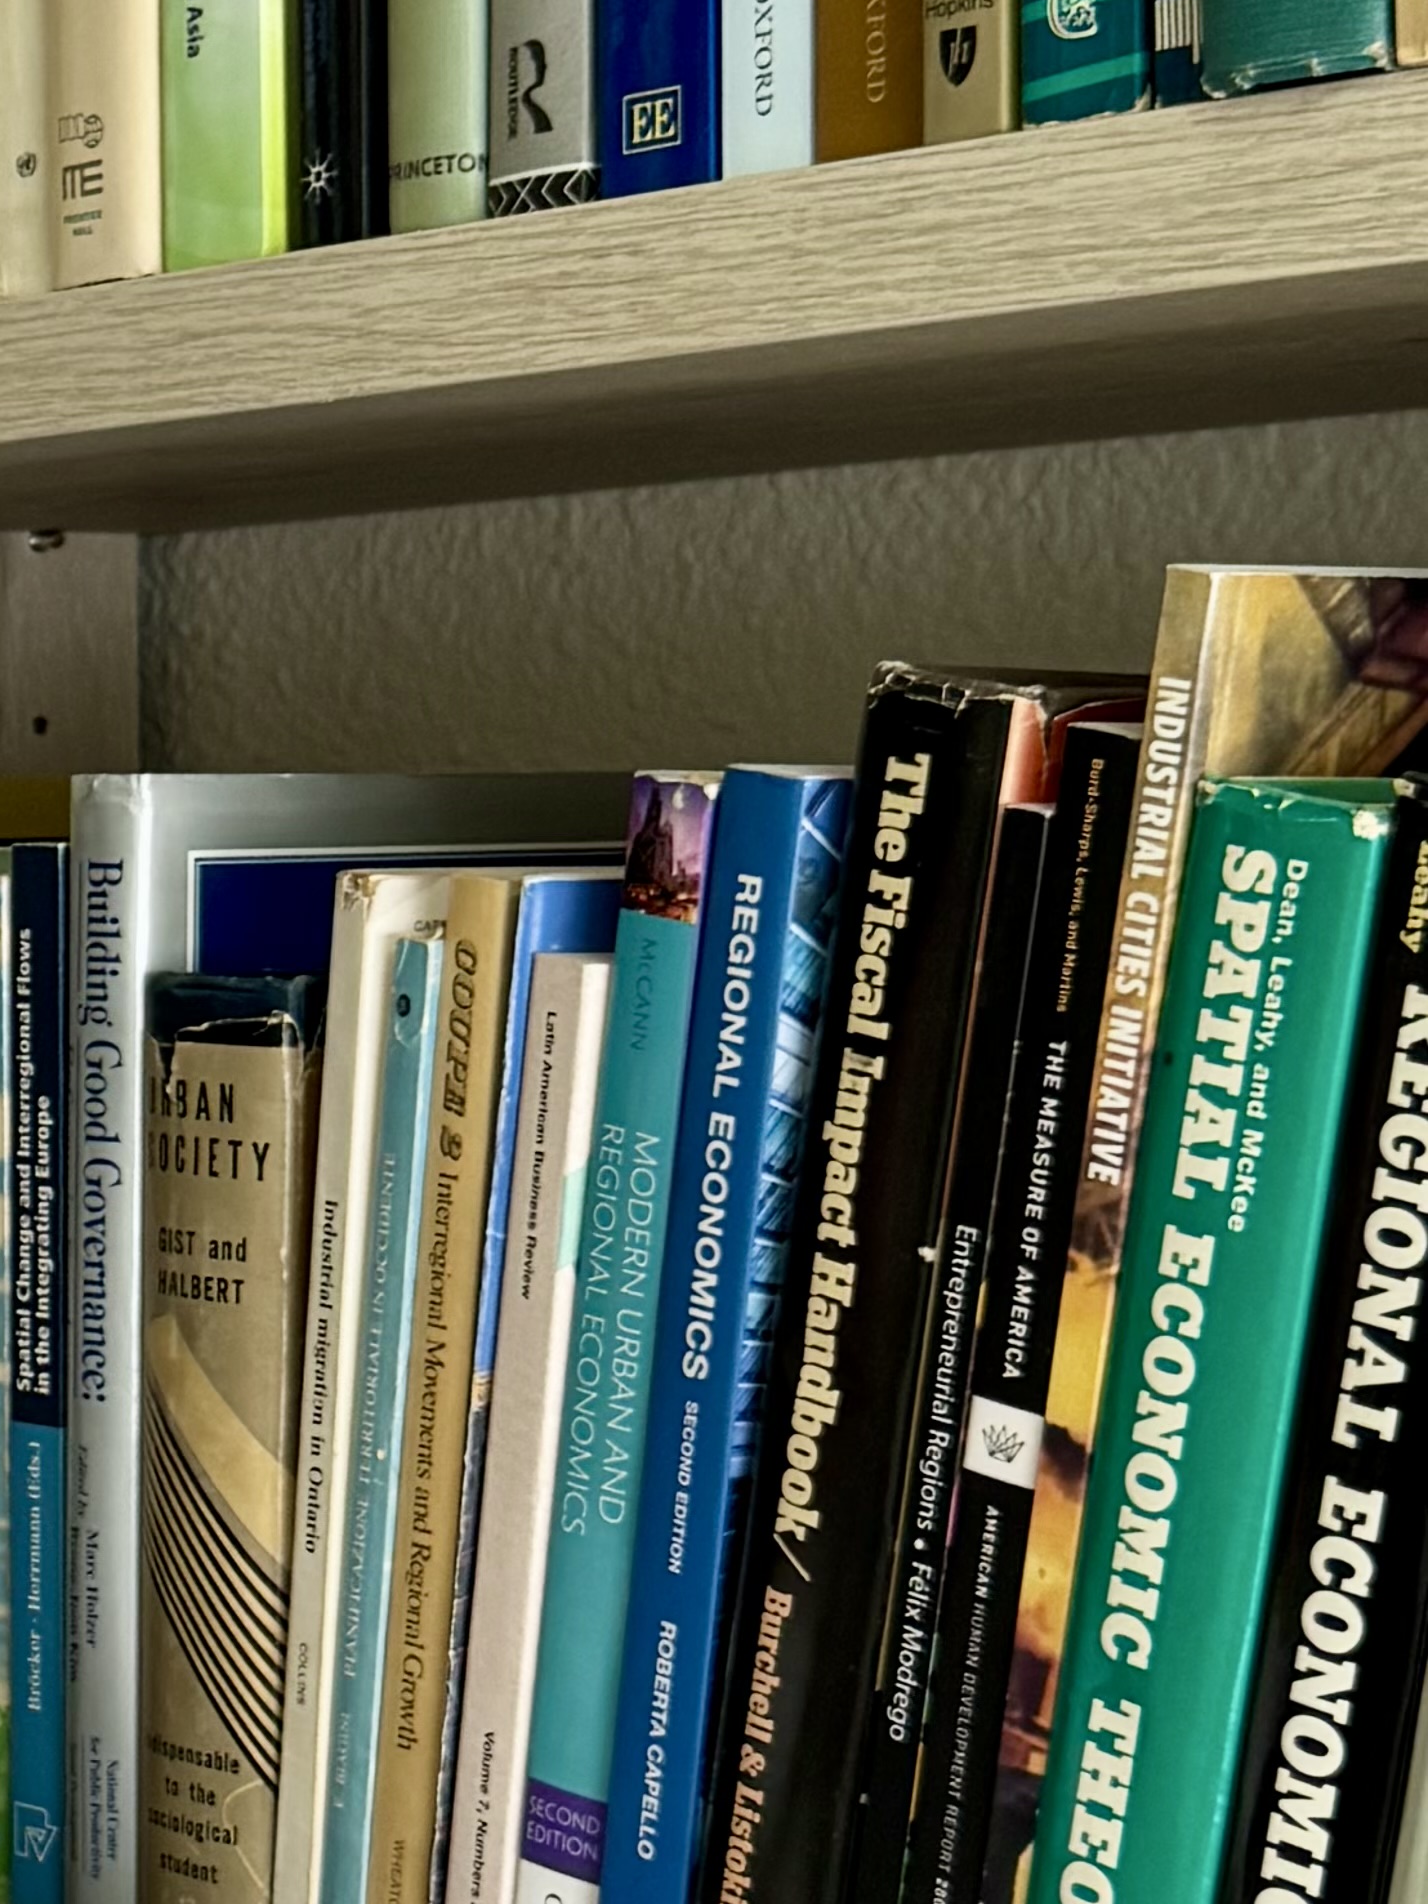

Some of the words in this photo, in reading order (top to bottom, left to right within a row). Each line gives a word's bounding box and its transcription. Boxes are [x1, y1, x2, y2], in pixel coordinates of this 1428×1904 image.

[875, 753, 932, 866] The
[1129, 675, 1192, 886] INDUSTRIAL
[713, 873, 763, 1098] REGIONAL
[847, 874, 910, 1042] Fiscal
[1114, 892, 1159, 1000] CITIES
[1087, 1007, 1145, 1187] INITIATIVE
[1171, 845, 1278, 1202] SPATIAL
[816, 1050, 885, 1245] Impact
[159, 1227, 196, 1256] GIST
[209, 1236, 247, 1262] and
[159, 1276, 245, 1306] HALBERT
[682, 1113, 735, 1380] ECONOMICS
[1100, 1225, 1216, 1669] ECONOMIC
[649, 1621, 678, 1738] ROBERTA
[747, 1587, 793, 1737] Burchell
[526, 1823, 600, 1862] EDITION
[527, 1797, 601, 1836] SECOND
[636, 1746, 664, 1861] CAPELLO
